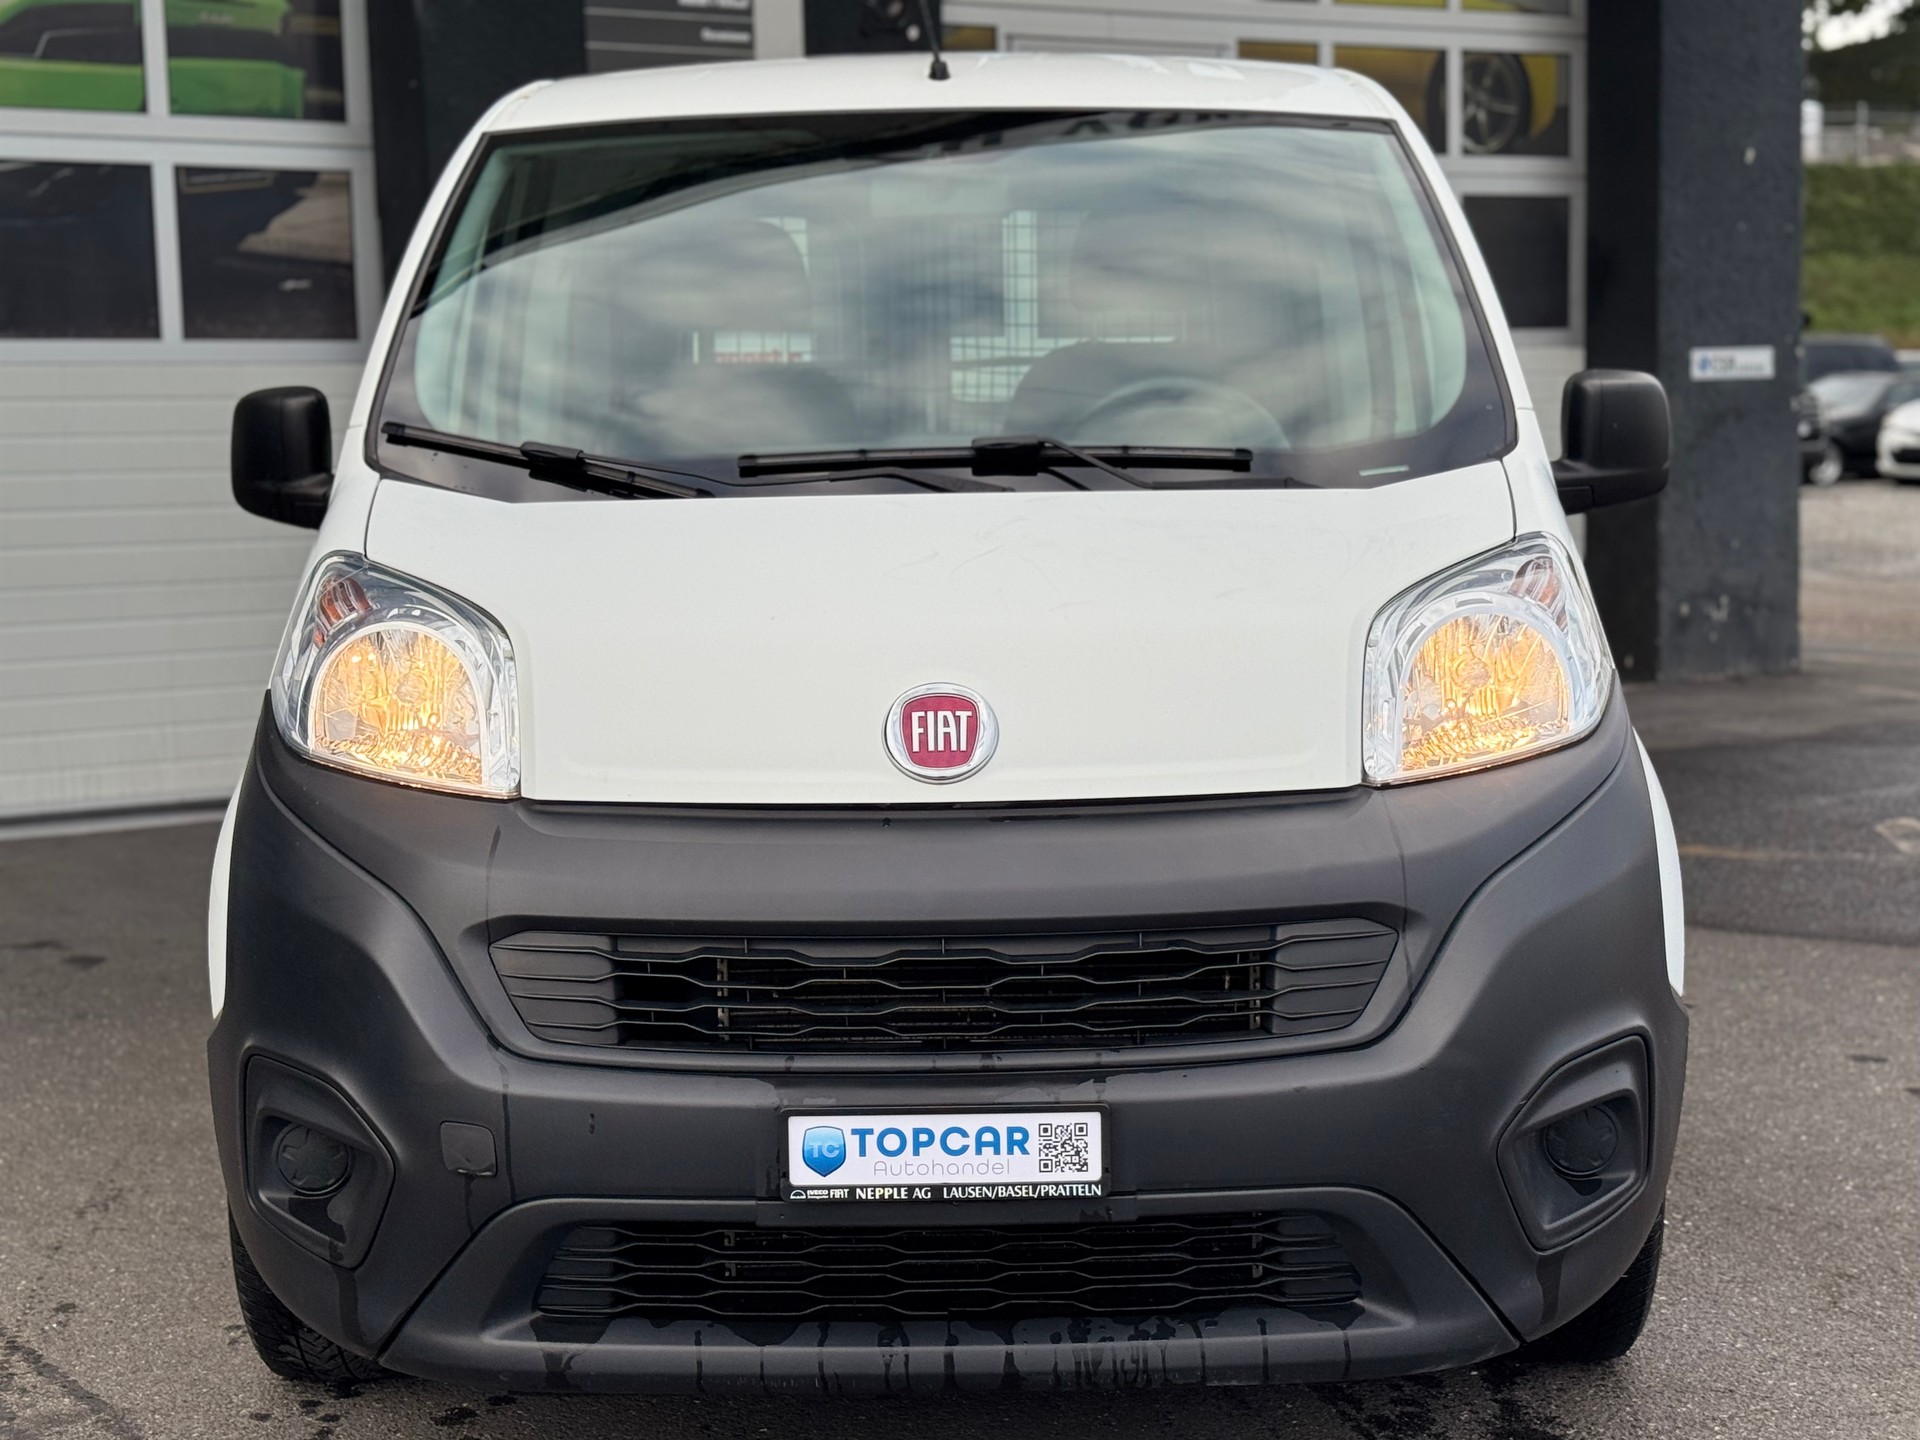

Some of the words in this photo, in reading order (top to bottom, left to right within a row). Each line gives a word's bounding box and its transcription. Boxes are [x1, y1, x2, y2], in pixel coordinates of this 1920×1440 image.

[911, 710, 973, 752] FIAT
[808, 1142, 840, 1158] TC
[850, 1126, 1030, 1157] TOPCAR
[873, 1159, 1010, 1176] Autohandel
[829, 1188, 850, 1199] FIAT
[855, 1187, 908, 1199] NEPPLE
[912, 1187, 932, 1199] AG
[943, 1184, 1102, 1199] LAUSEN/BASEL/PRATTELN
